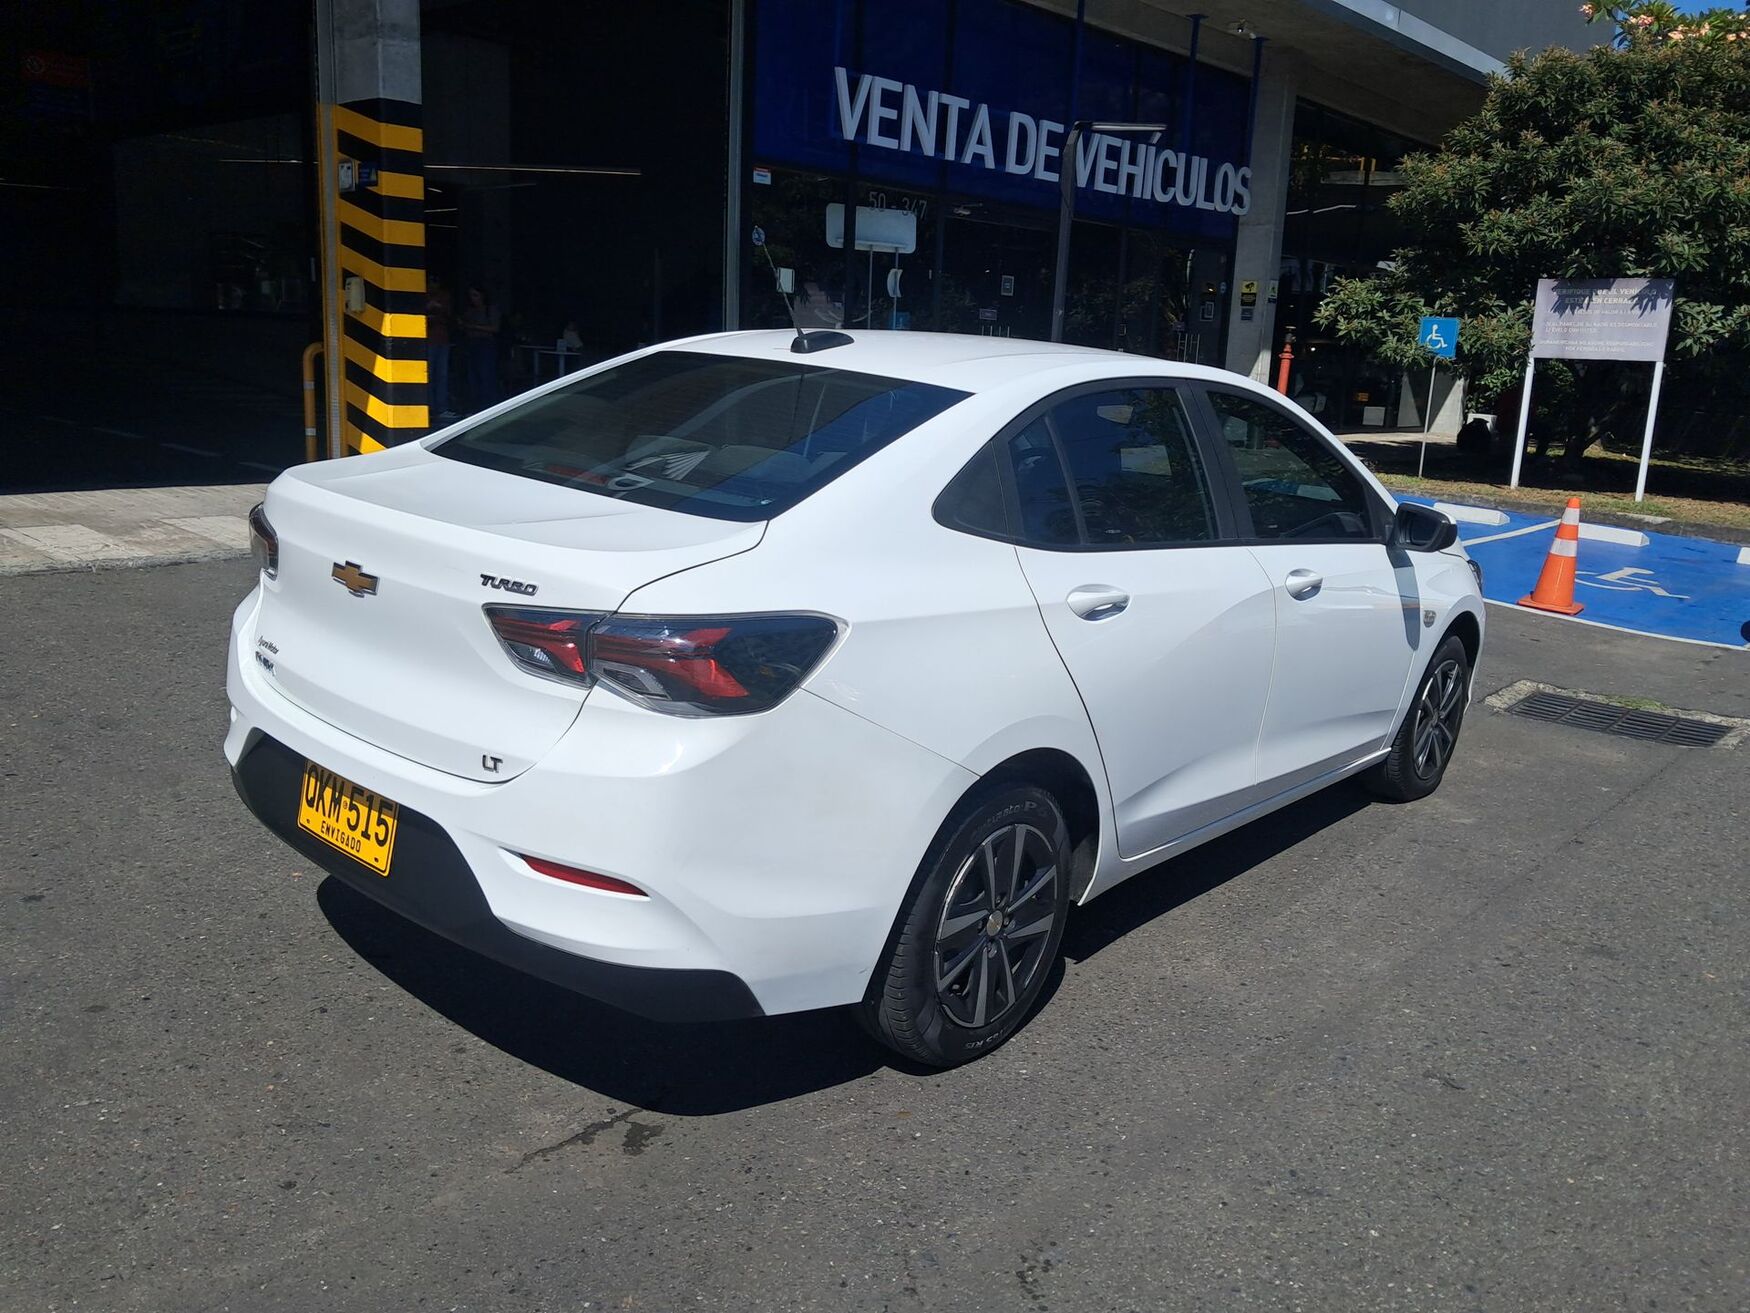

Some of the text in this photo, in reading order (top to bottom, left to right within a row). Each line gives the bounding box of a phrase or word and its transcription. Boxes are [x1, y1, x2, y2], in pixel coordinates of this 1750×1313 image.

[834, 66, 1253, 215] VENTA DE VEHÍCULOS
[869, 191, 886, 212] 50
[480, 573, 538, 597] TURBO
[482, 754, 503, 773] LT
[305, 764, 394, 847] QKM 515
[320, 820, 362, 853] ENVIGADO
